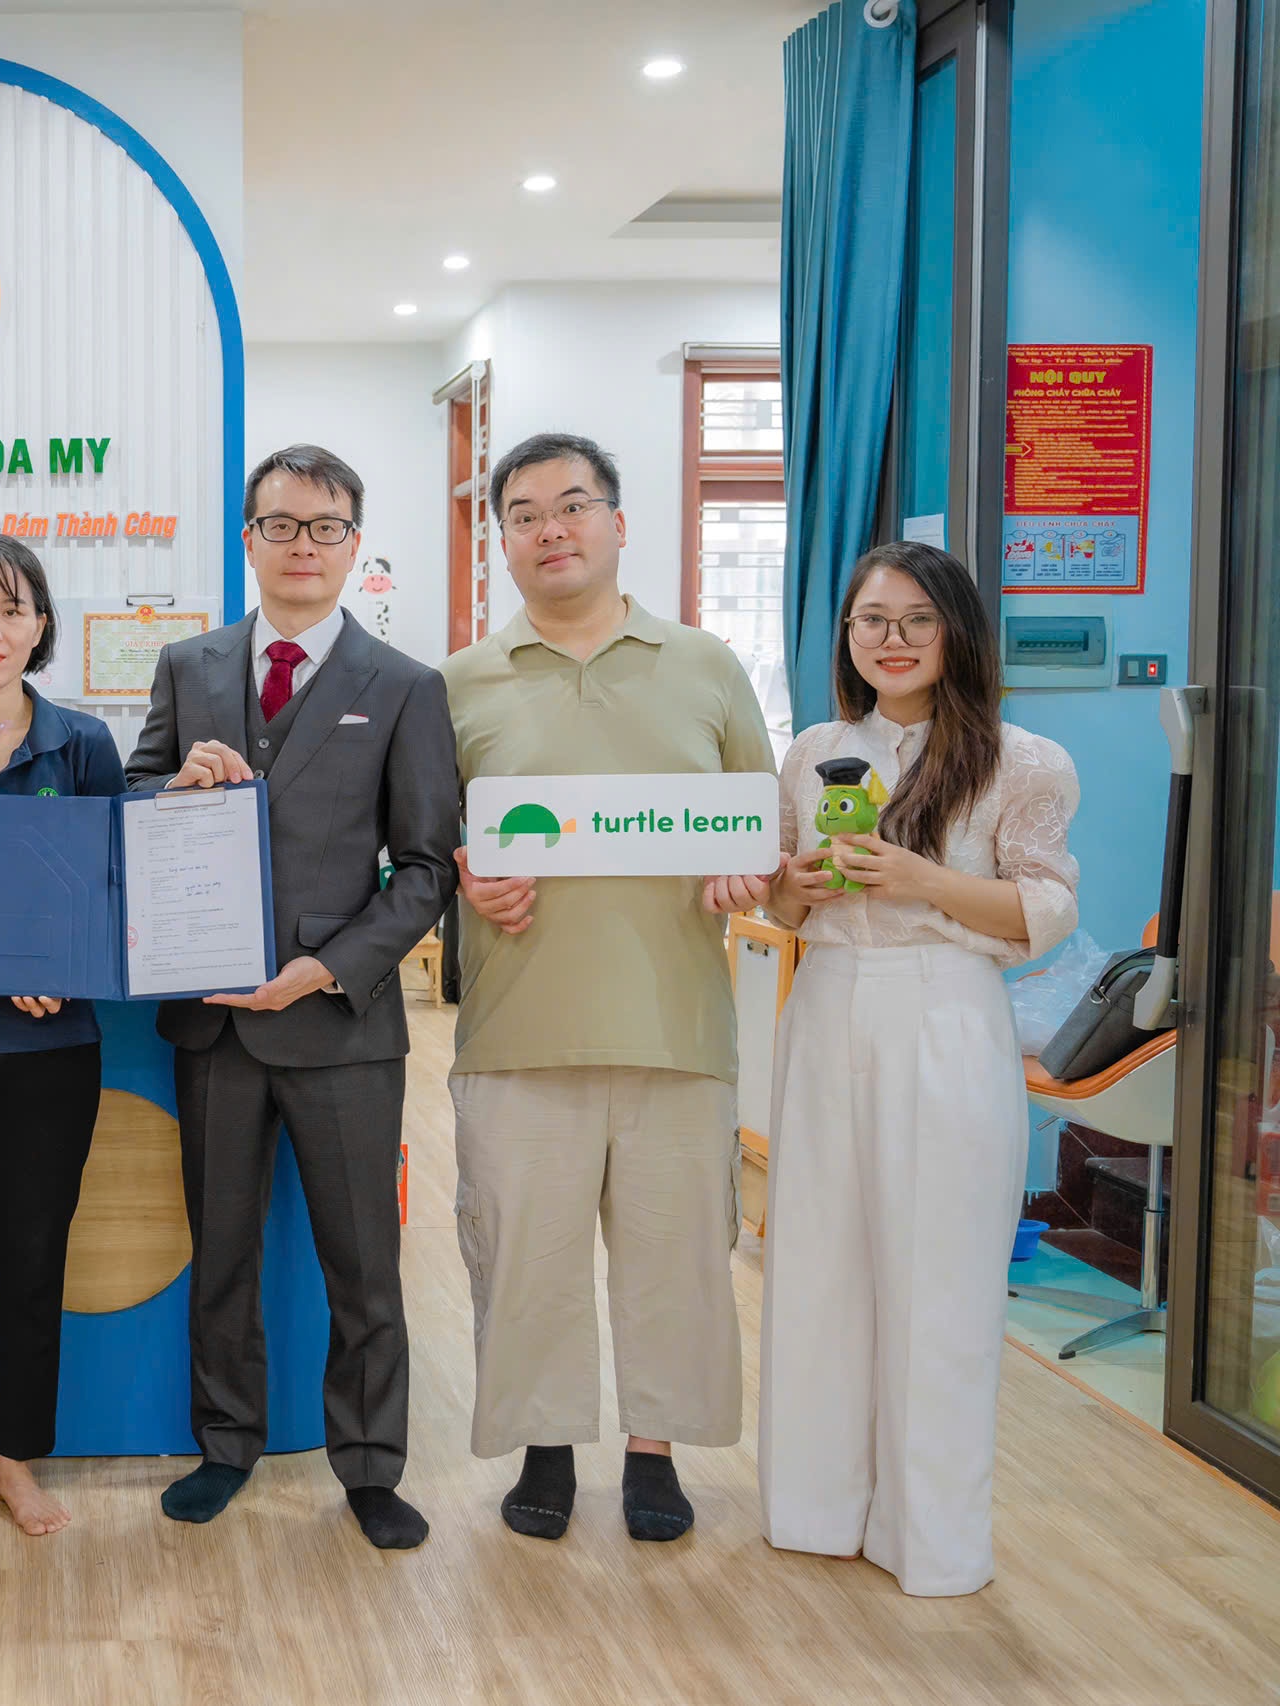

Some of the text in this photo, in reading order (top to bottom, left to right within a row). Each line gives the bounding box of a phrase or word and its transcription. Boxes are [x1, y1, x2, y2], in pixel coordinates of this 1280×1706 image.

[1030, 369, 1107, 385] NỘI QUY
[1014, 387, 1044, 397] PHÒNG
[1046, 387, 1070, 397] CHÁY
[1097, 387, 1122, 397] CHÁY
[49, 437, 111, 475] MY
[1, 513, 49, 537] Dám
[56, 511, 119, 537] Thành
[123, 511, 177, 539] Công
[592, 808, 763, 833] turtle learn
